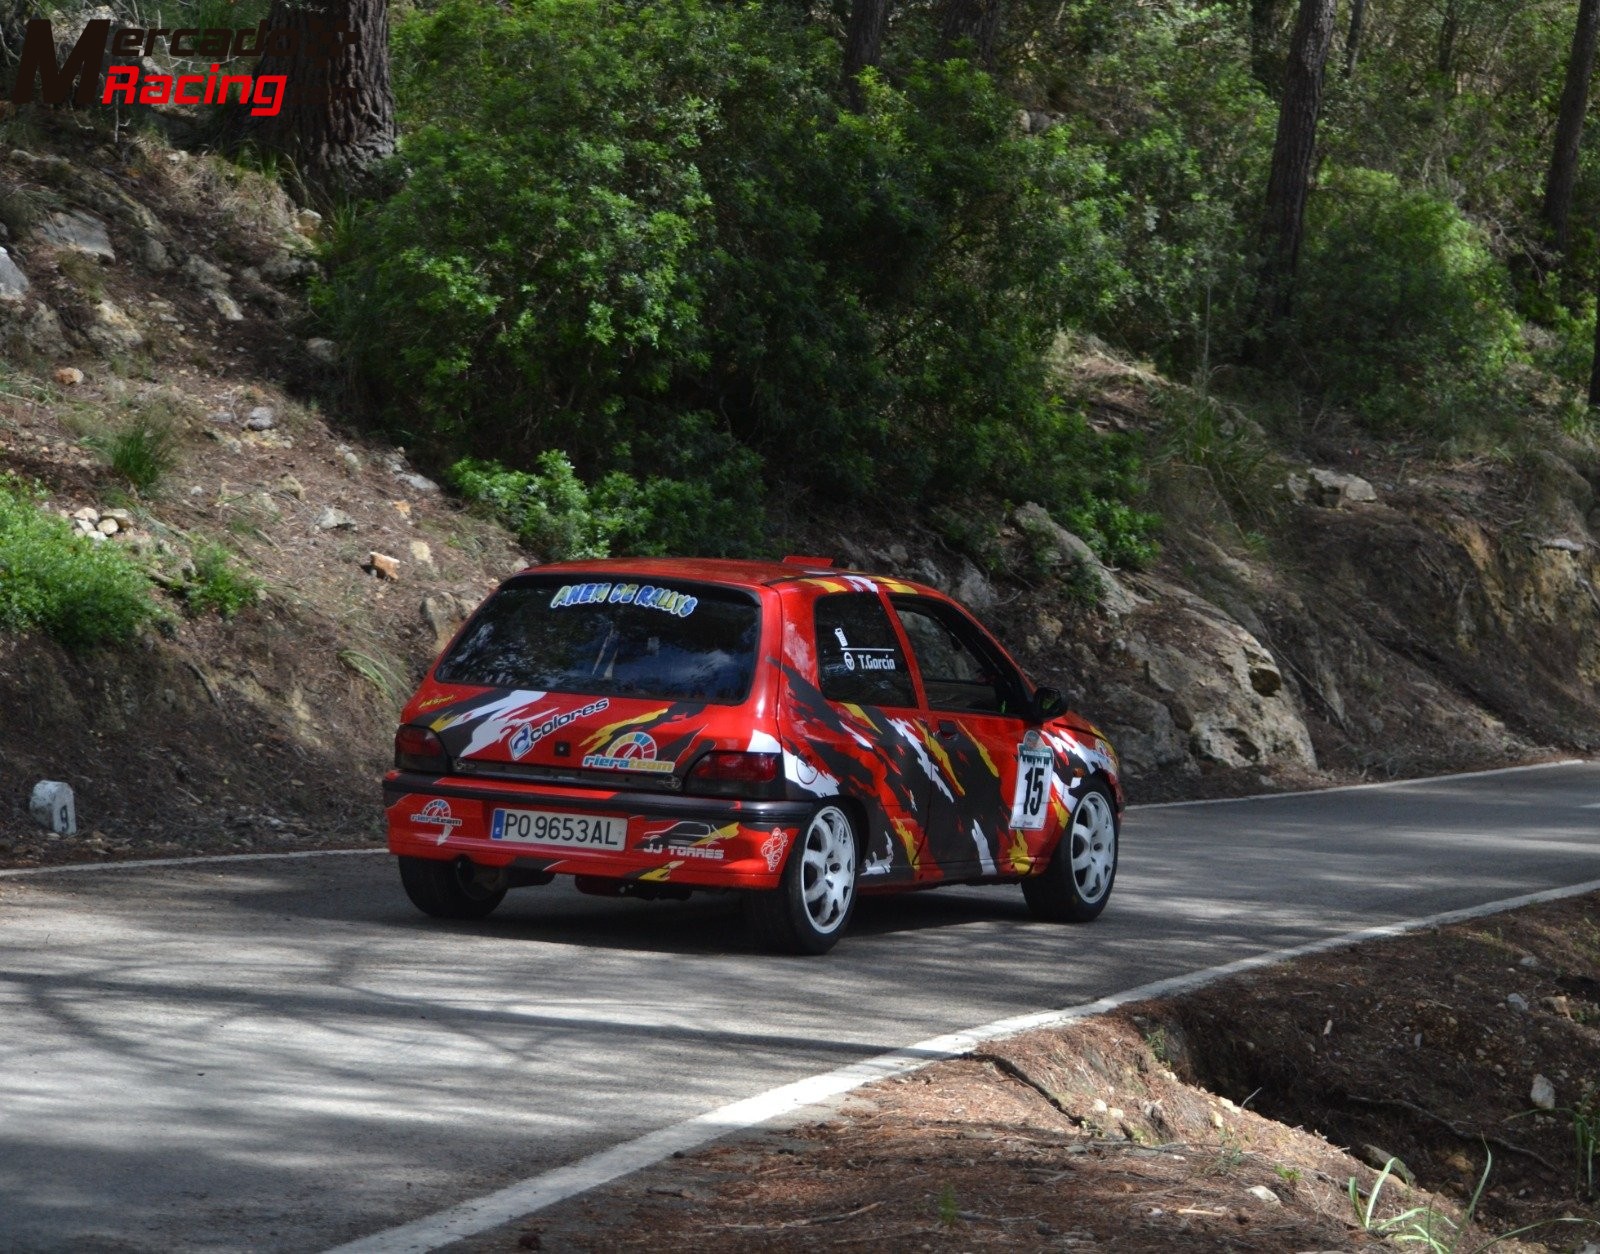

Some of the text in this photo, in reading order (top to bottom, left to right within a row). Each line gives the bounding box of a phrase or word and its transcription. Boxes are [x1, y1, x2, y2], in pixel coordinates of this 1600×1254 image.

[550, 583, 698, 617] ANEM DE RALLYS
[584, 756, 674, 772] rierateam
[1023, 766, 1044, 816] 15
[644, 844, 724, 859] JJ TORRES
